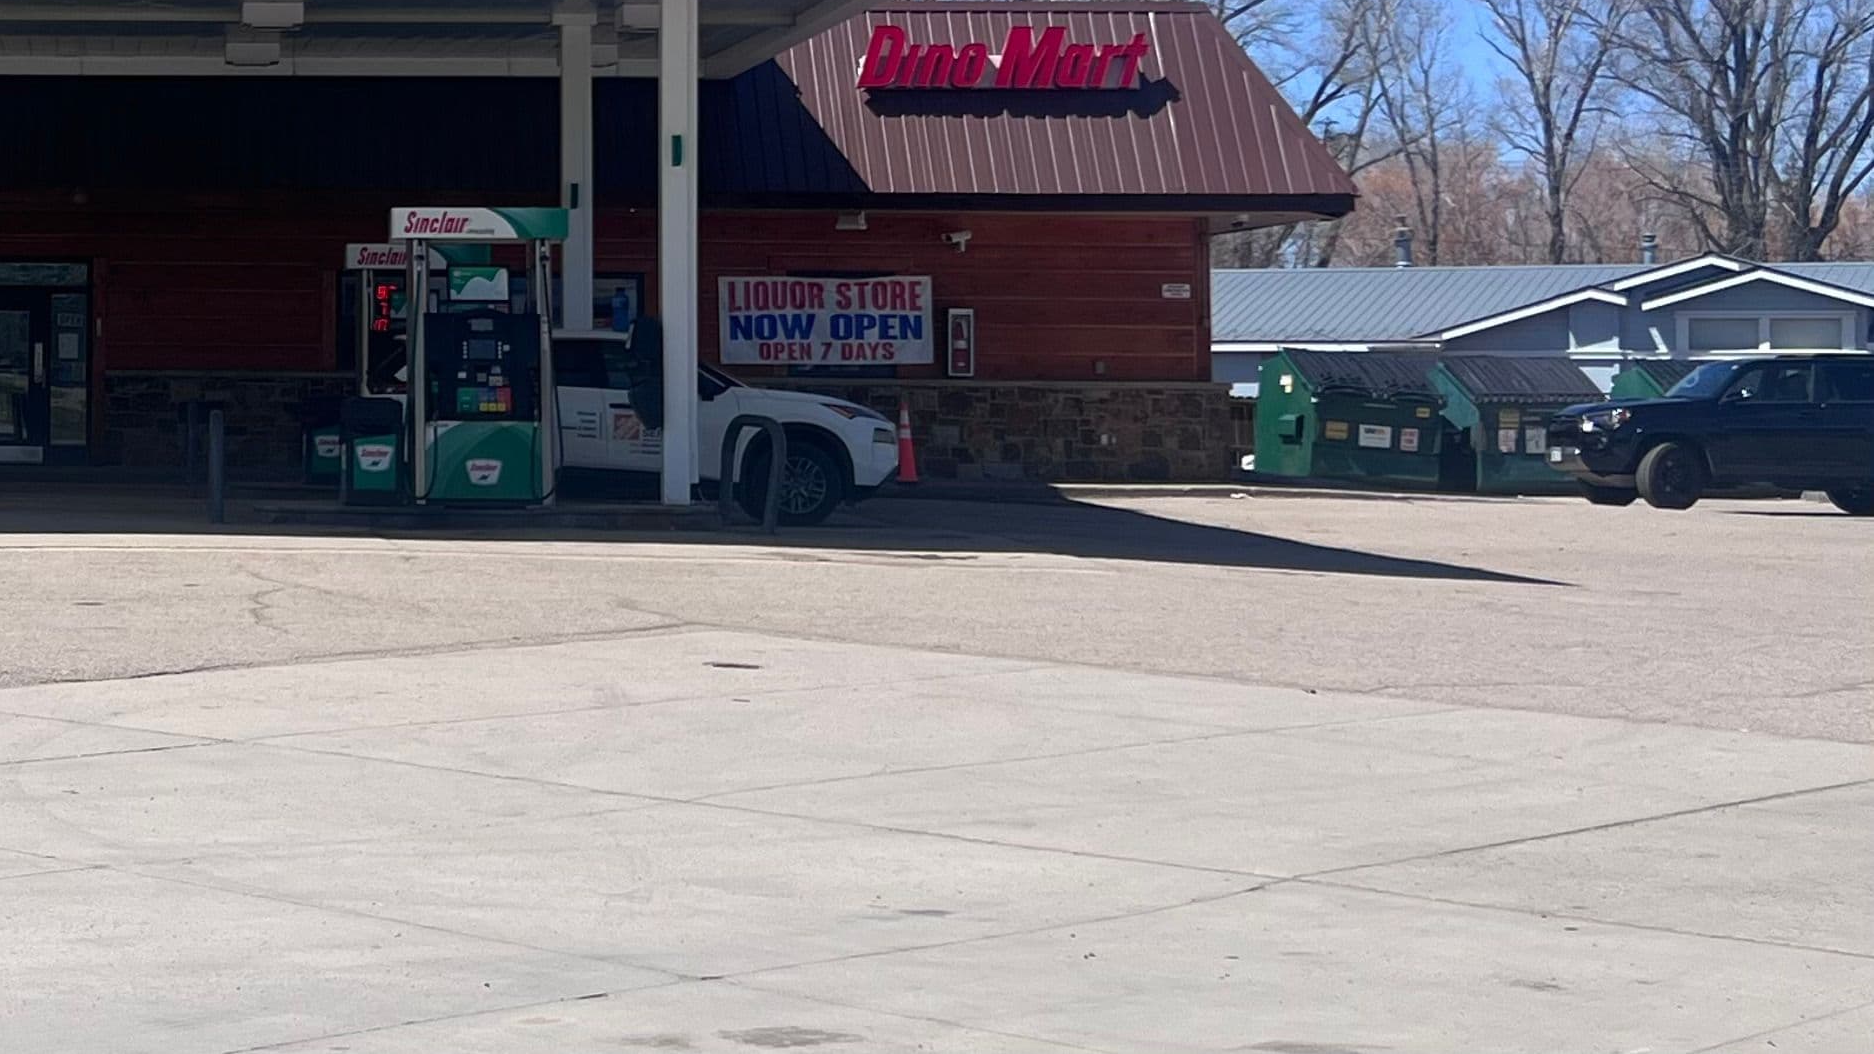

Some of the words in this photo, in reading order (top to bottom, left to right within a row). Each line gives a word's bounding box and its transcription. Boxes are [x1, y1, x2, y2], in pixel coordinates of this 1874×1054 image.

[857, 25, 987, 89] Dino
[994, 26, 1150, 89] Mart
[404, 210, 469, 234] Sinclair
[357, 246, 407, 266] Sinclai
[728, 280, 825, 311] LIQUOR
[835, 280, 923, 311] STORE
[729, 314, 816, 340] NOW
[830, 314, 923, 340] OPEN
[759, 342, 812, 361] OPEN
[820, 342, 833, 361] 7
[841, 342, 895, 361] DAYS
